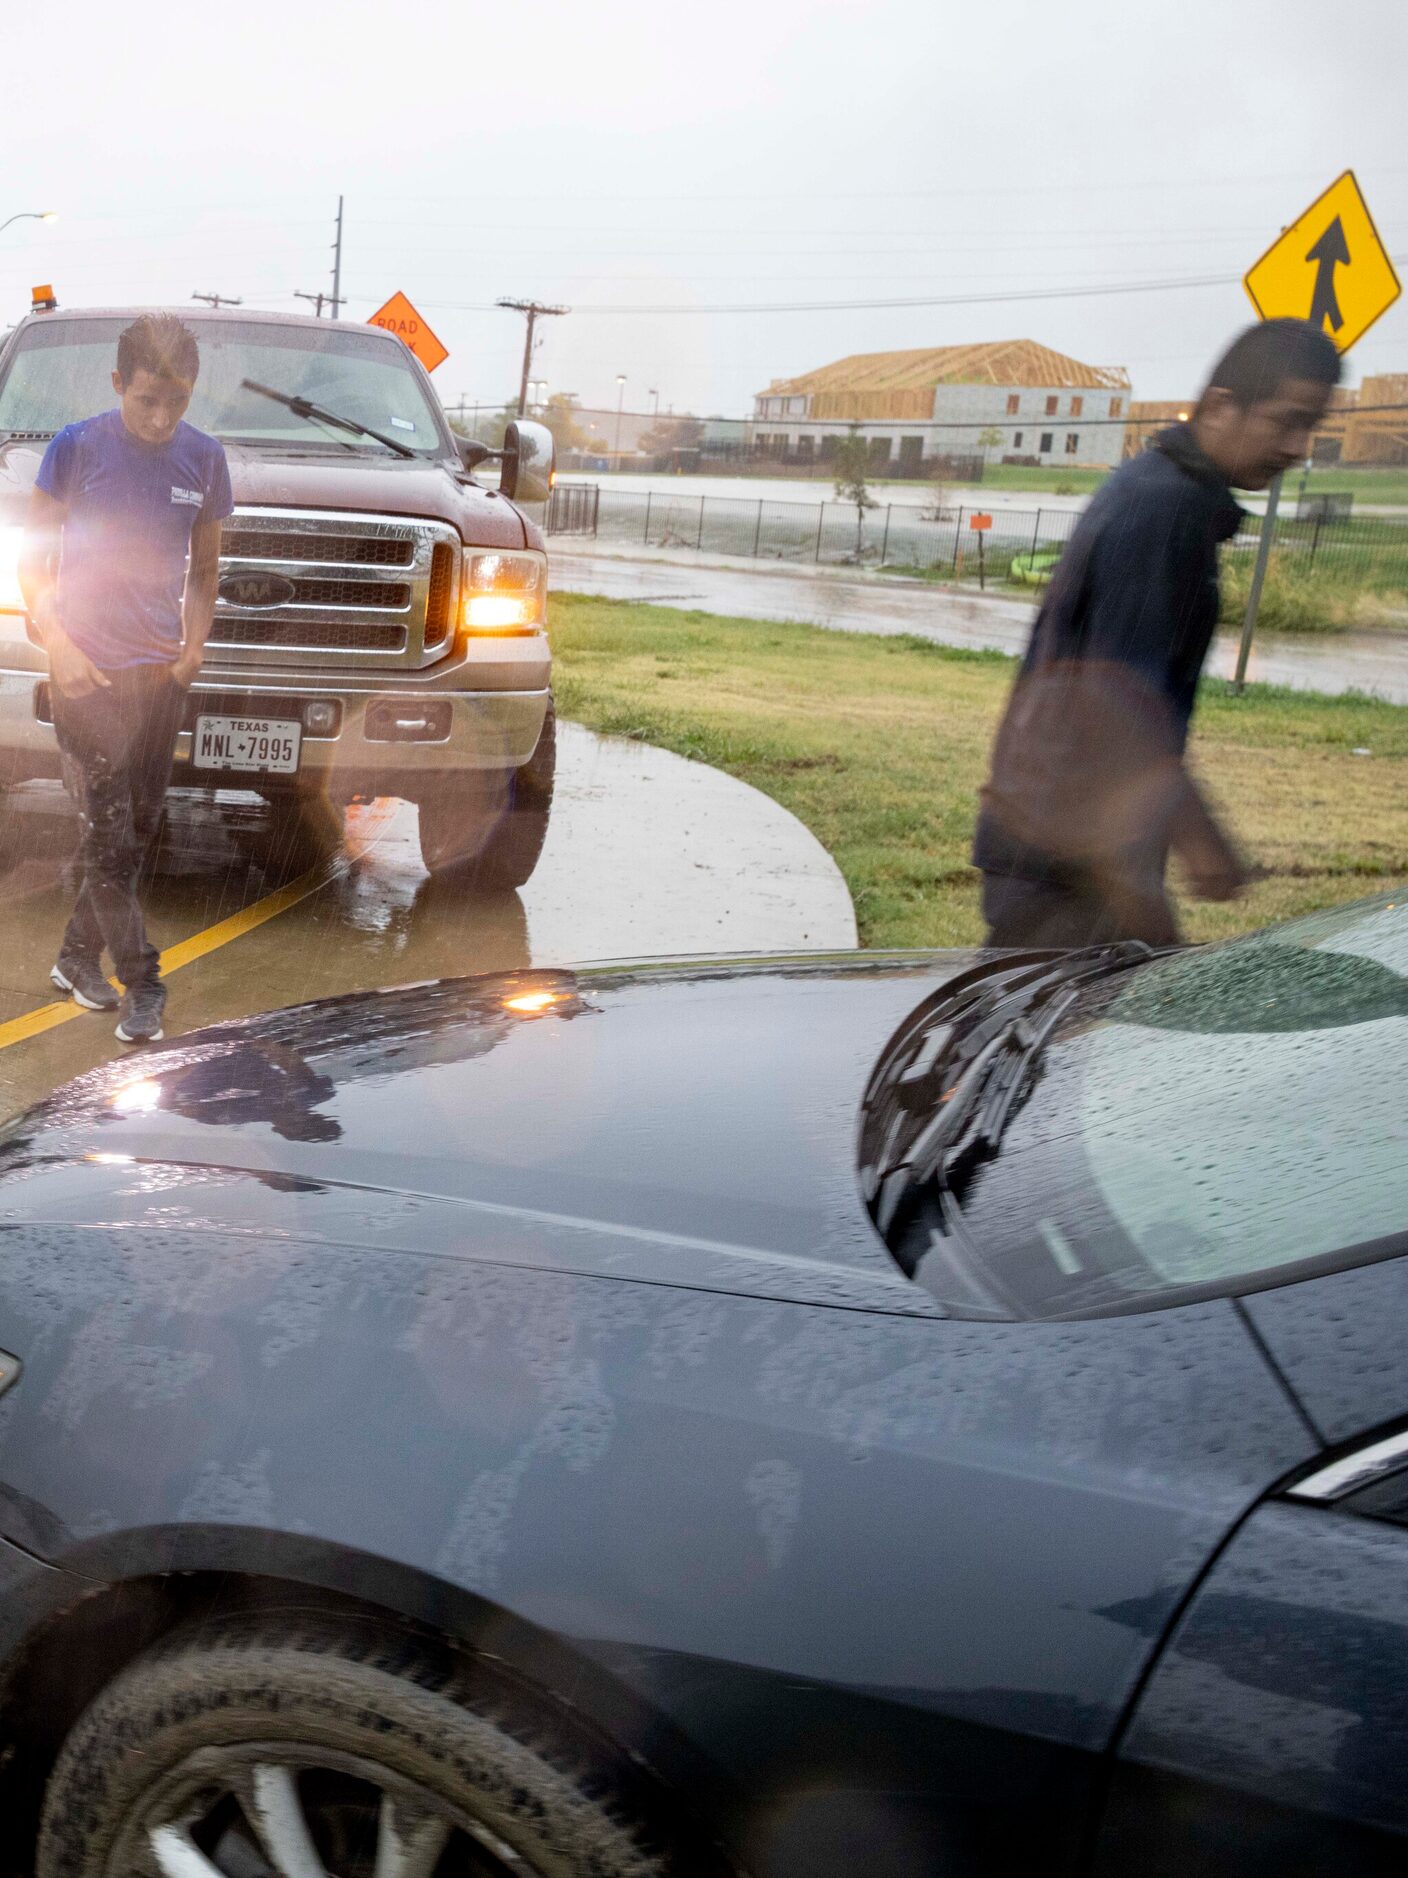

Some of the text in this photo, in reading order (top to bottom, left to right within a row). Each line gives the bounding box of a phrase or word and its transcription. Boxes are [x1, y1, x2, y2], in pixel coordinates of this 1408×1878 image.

[230, 720, 269, 732] TEXAS
[201, 734, 293, 762] MNL 7995
